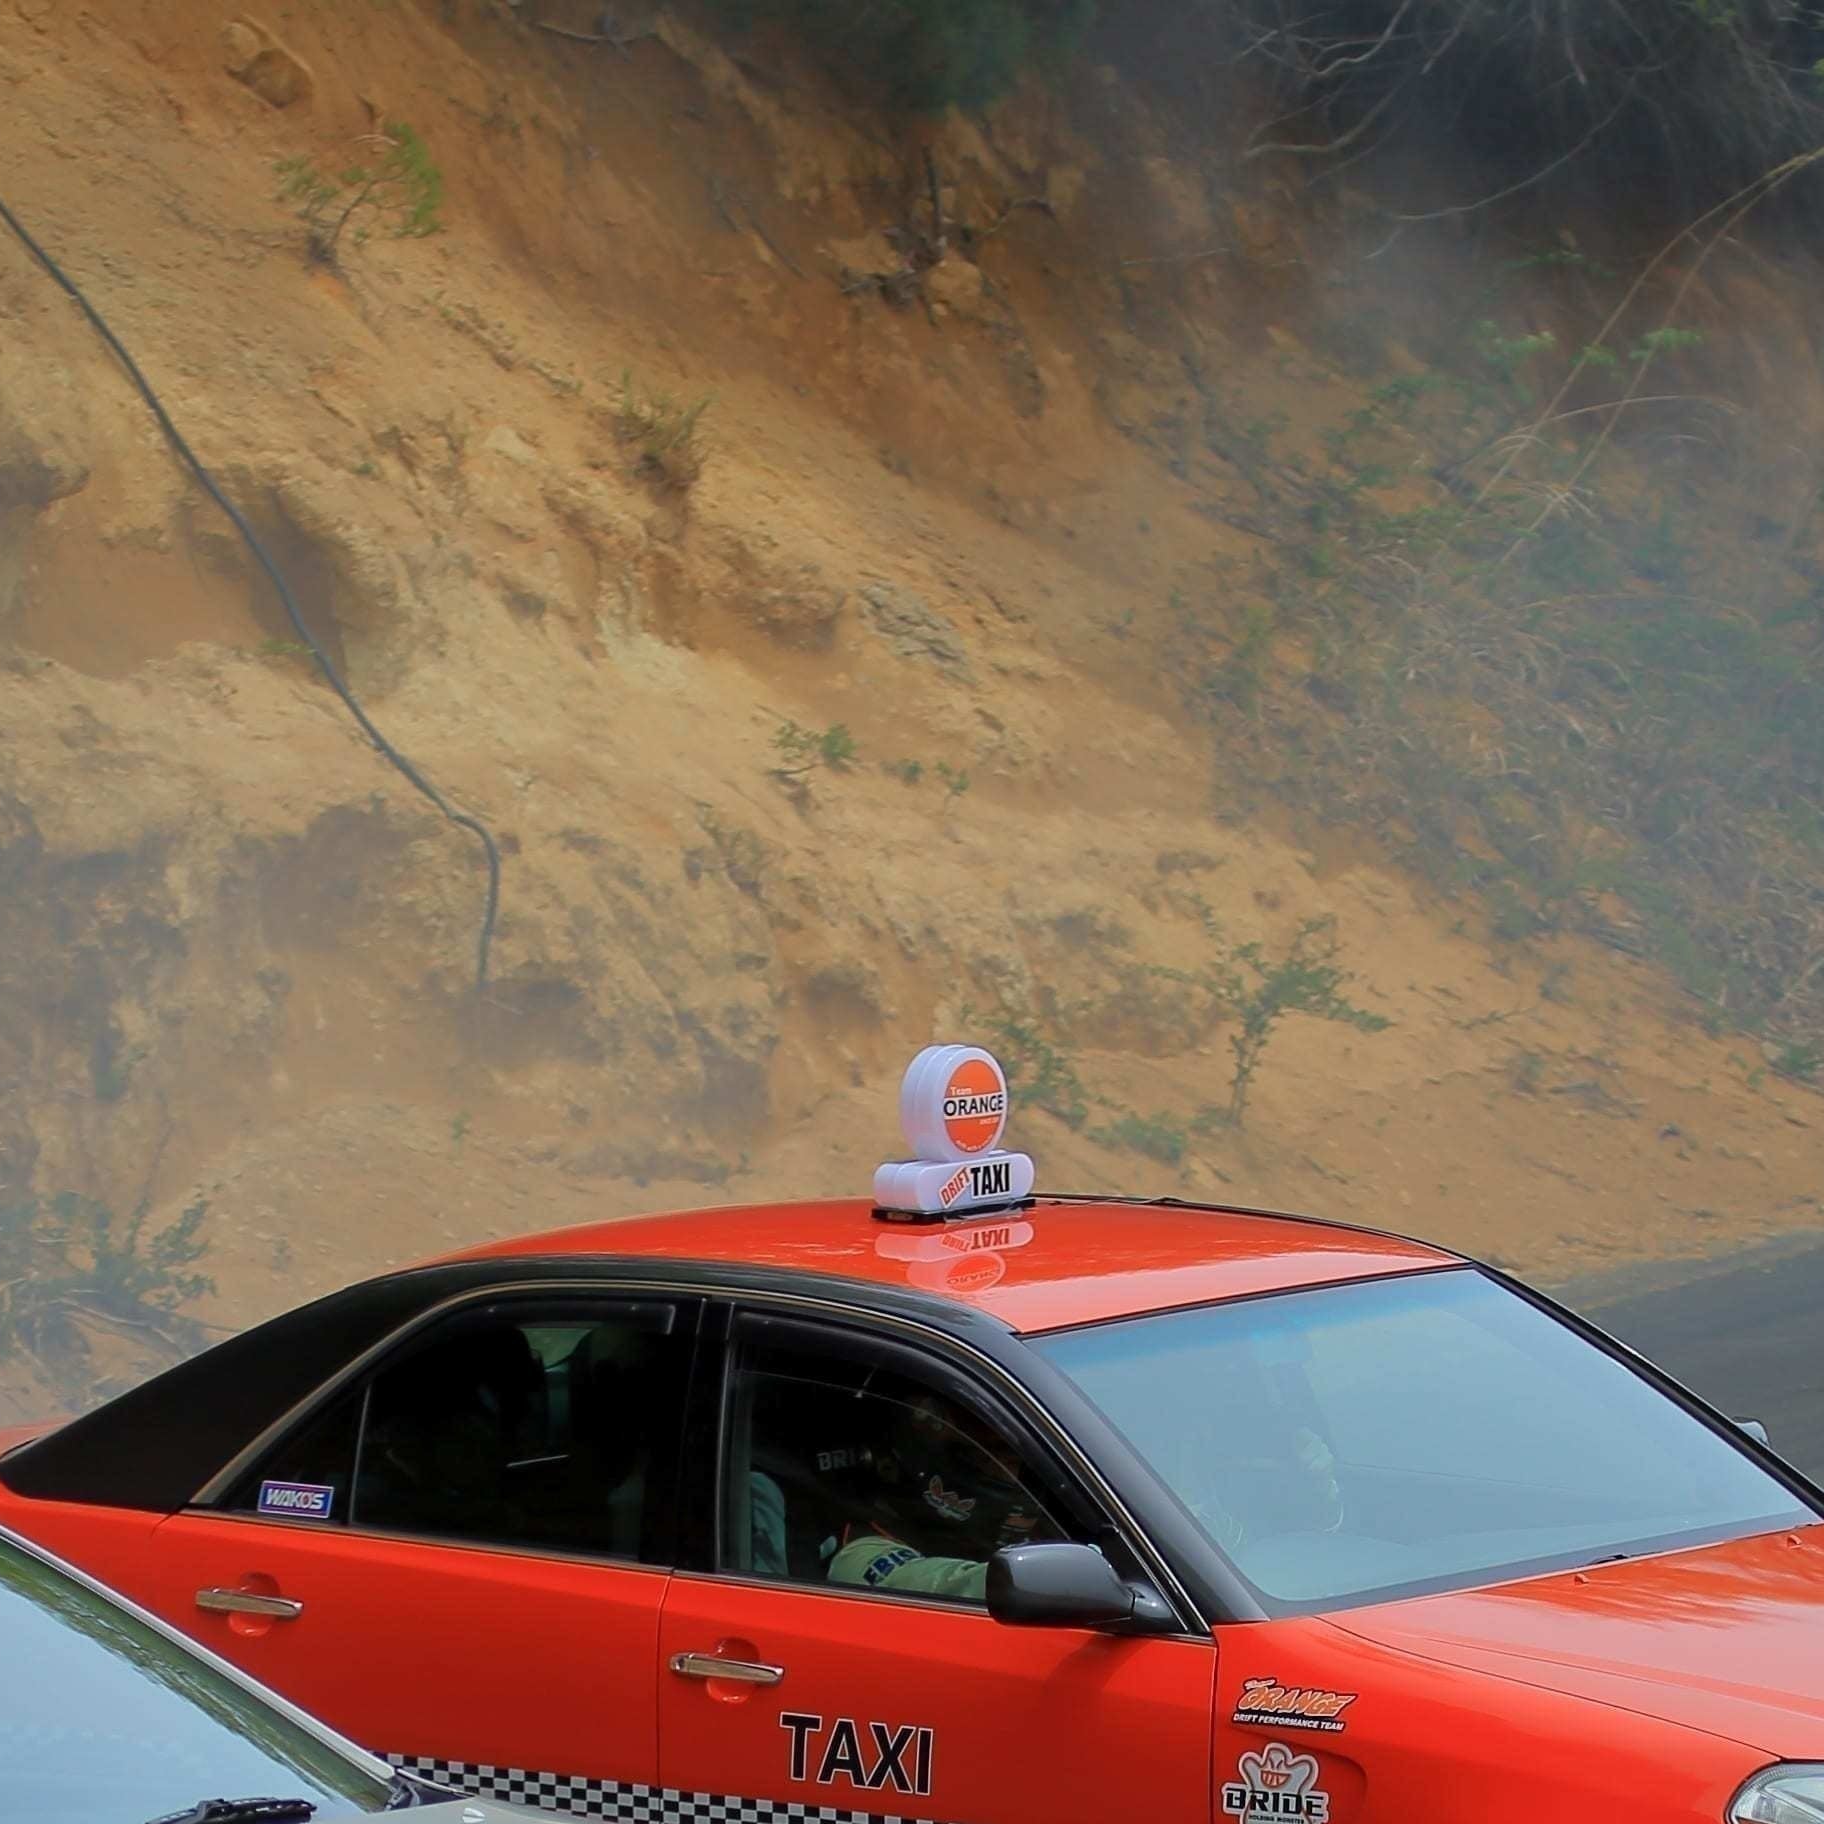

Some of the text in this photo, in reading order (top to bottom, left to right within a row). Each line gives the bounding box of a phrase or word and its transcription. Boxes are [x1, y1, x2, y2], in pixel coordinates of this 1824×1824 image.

[944, 1094, 1003, 1116] ORANGE
[941, 1163, 1010, 1205] DRIFT TAXI
[1238, 1686, 1356, 1717] ORANGE
[1233, 1713, 1345, 1731] DRIFT PERFORMANCE TEAM
[779, 1711, 934, 1796] TAXI
[1226, 1787, 1324, 1818] BRIDE
